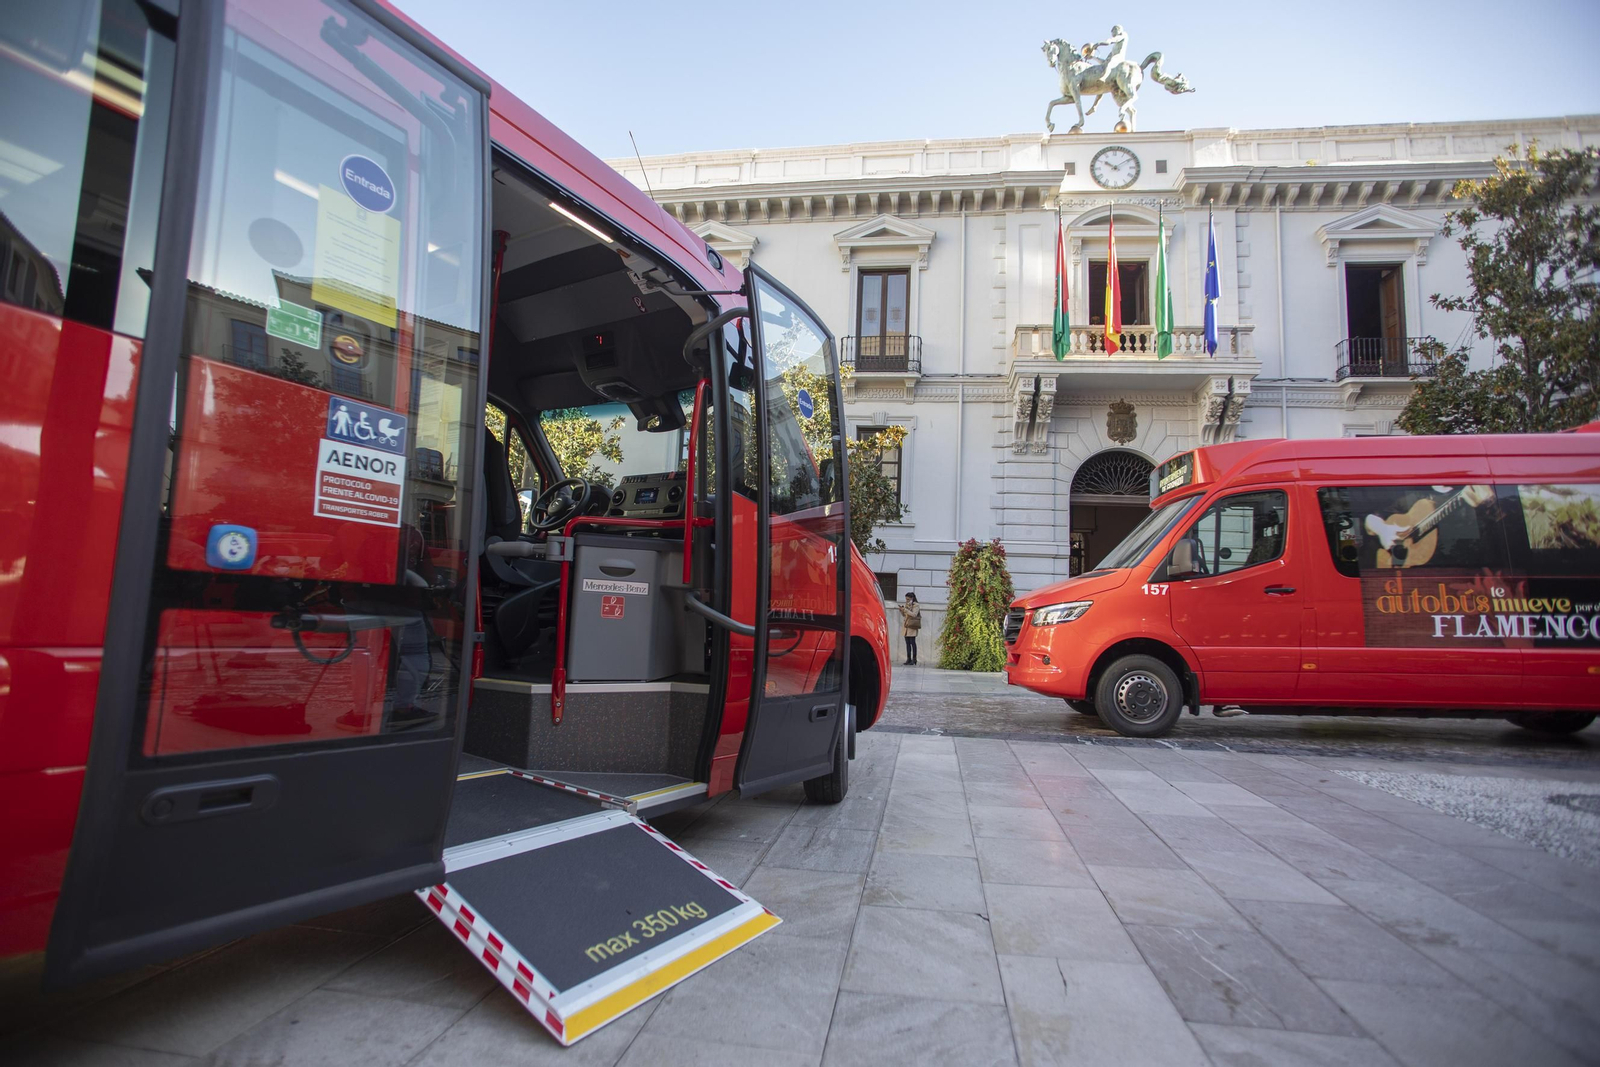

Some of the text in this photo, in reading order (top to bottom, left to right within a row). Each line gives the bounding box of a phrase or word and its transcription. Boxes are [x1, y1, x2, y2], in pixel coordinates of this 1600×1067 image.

[345, 168, 391, 200] Entrada
[326, 449, 397, 477] AENOR
[323, 475, 372, 490] PROTOCOLO
[322, 486, 398, 505] FRENTE AL COVID-19
[322, 503, 368, 516] TRANSPORTES
[828, 545, 838, 563] 1
[584, 581, 647, 594] Mercedes-Benz
[1141, 584, 1169, 595] 157
[1384, 570, 1403, 595] el
[1376, 583, 1490, 613] autobús
[1492, 598, 1571, 613] mueve
[1575, 603, 1593, 613] por
[1490, 586, 1505, 598] te
[584, 901, 708, 963] max 350 kg
